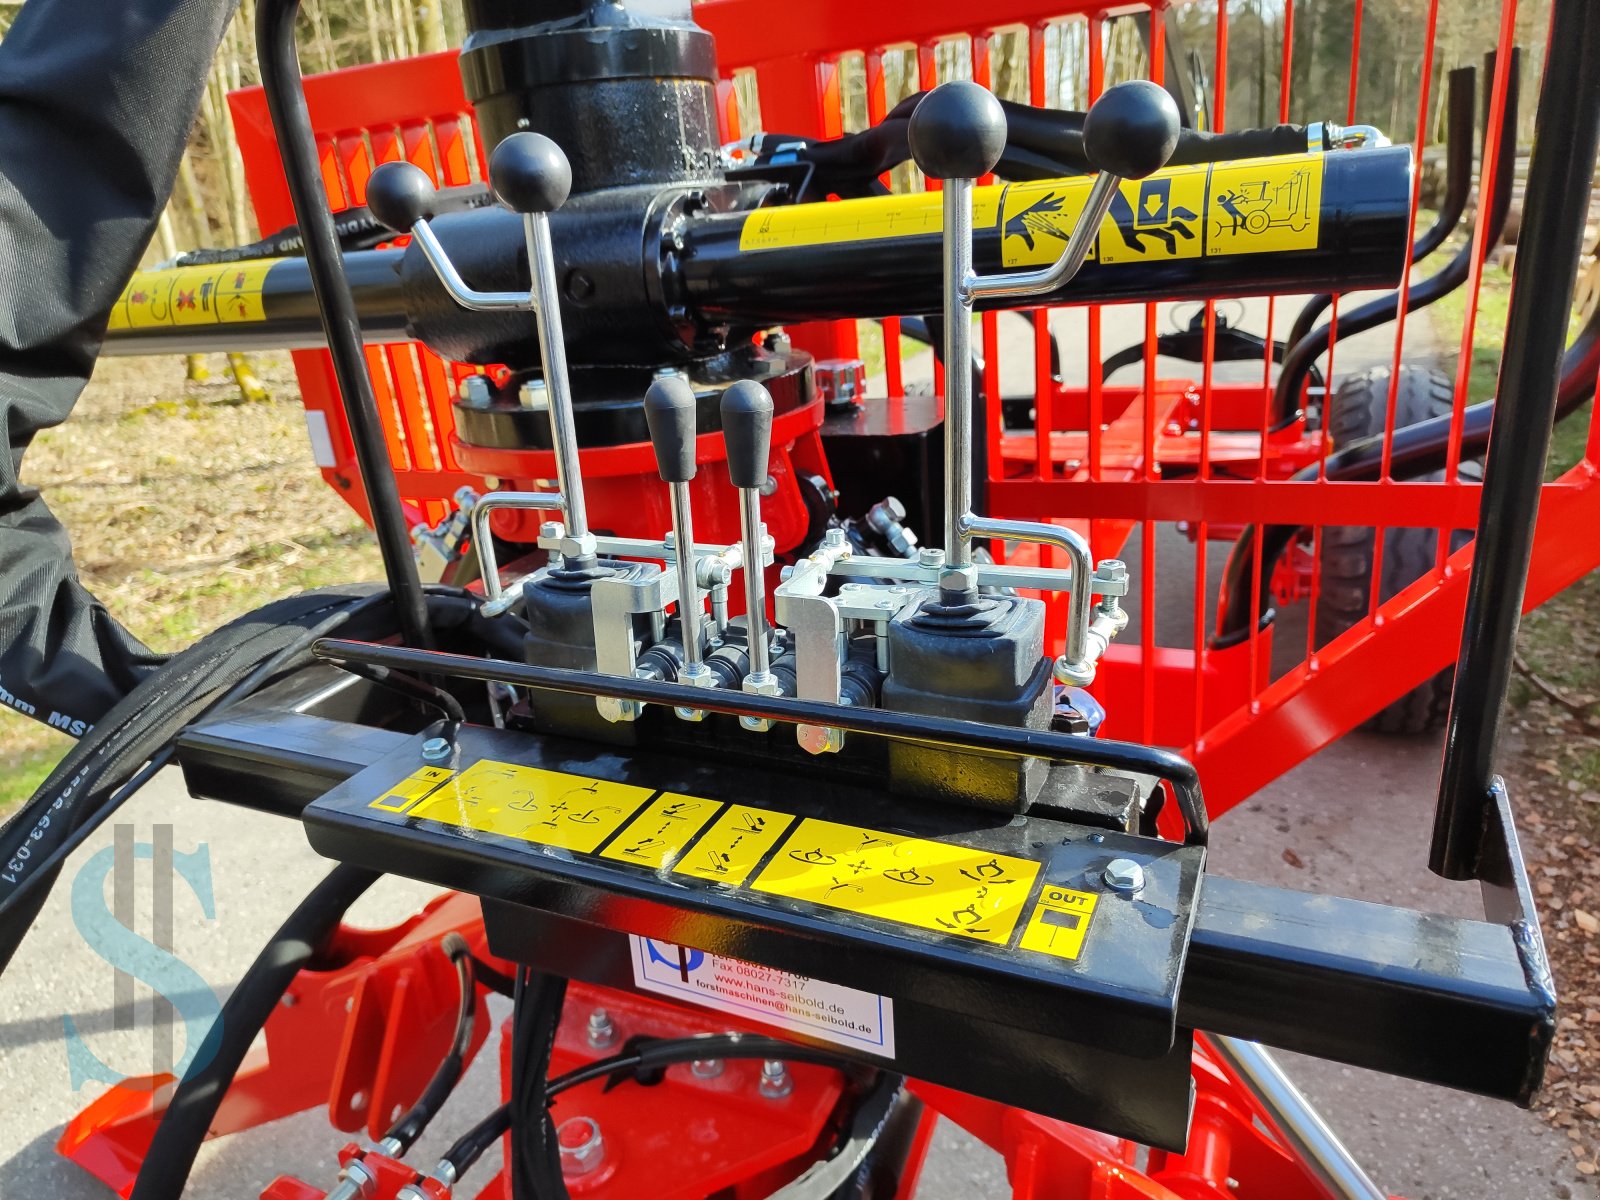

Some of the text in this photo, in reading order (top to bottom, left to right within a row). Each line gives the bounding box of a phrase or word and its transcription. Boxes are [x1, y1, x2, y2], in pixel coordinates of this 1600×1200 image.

[425, 770, 441, 778] IN
[1048, 891, 1089, 906] OUT
[713, 959, 733, 973] Fax
[736, 965, 806, 990] 08027-7317
[696, 979, 872, 1034] forstmaschinen@hans-seibold.de
[714, 973, 845, 1015] www.hans-seibold.de
